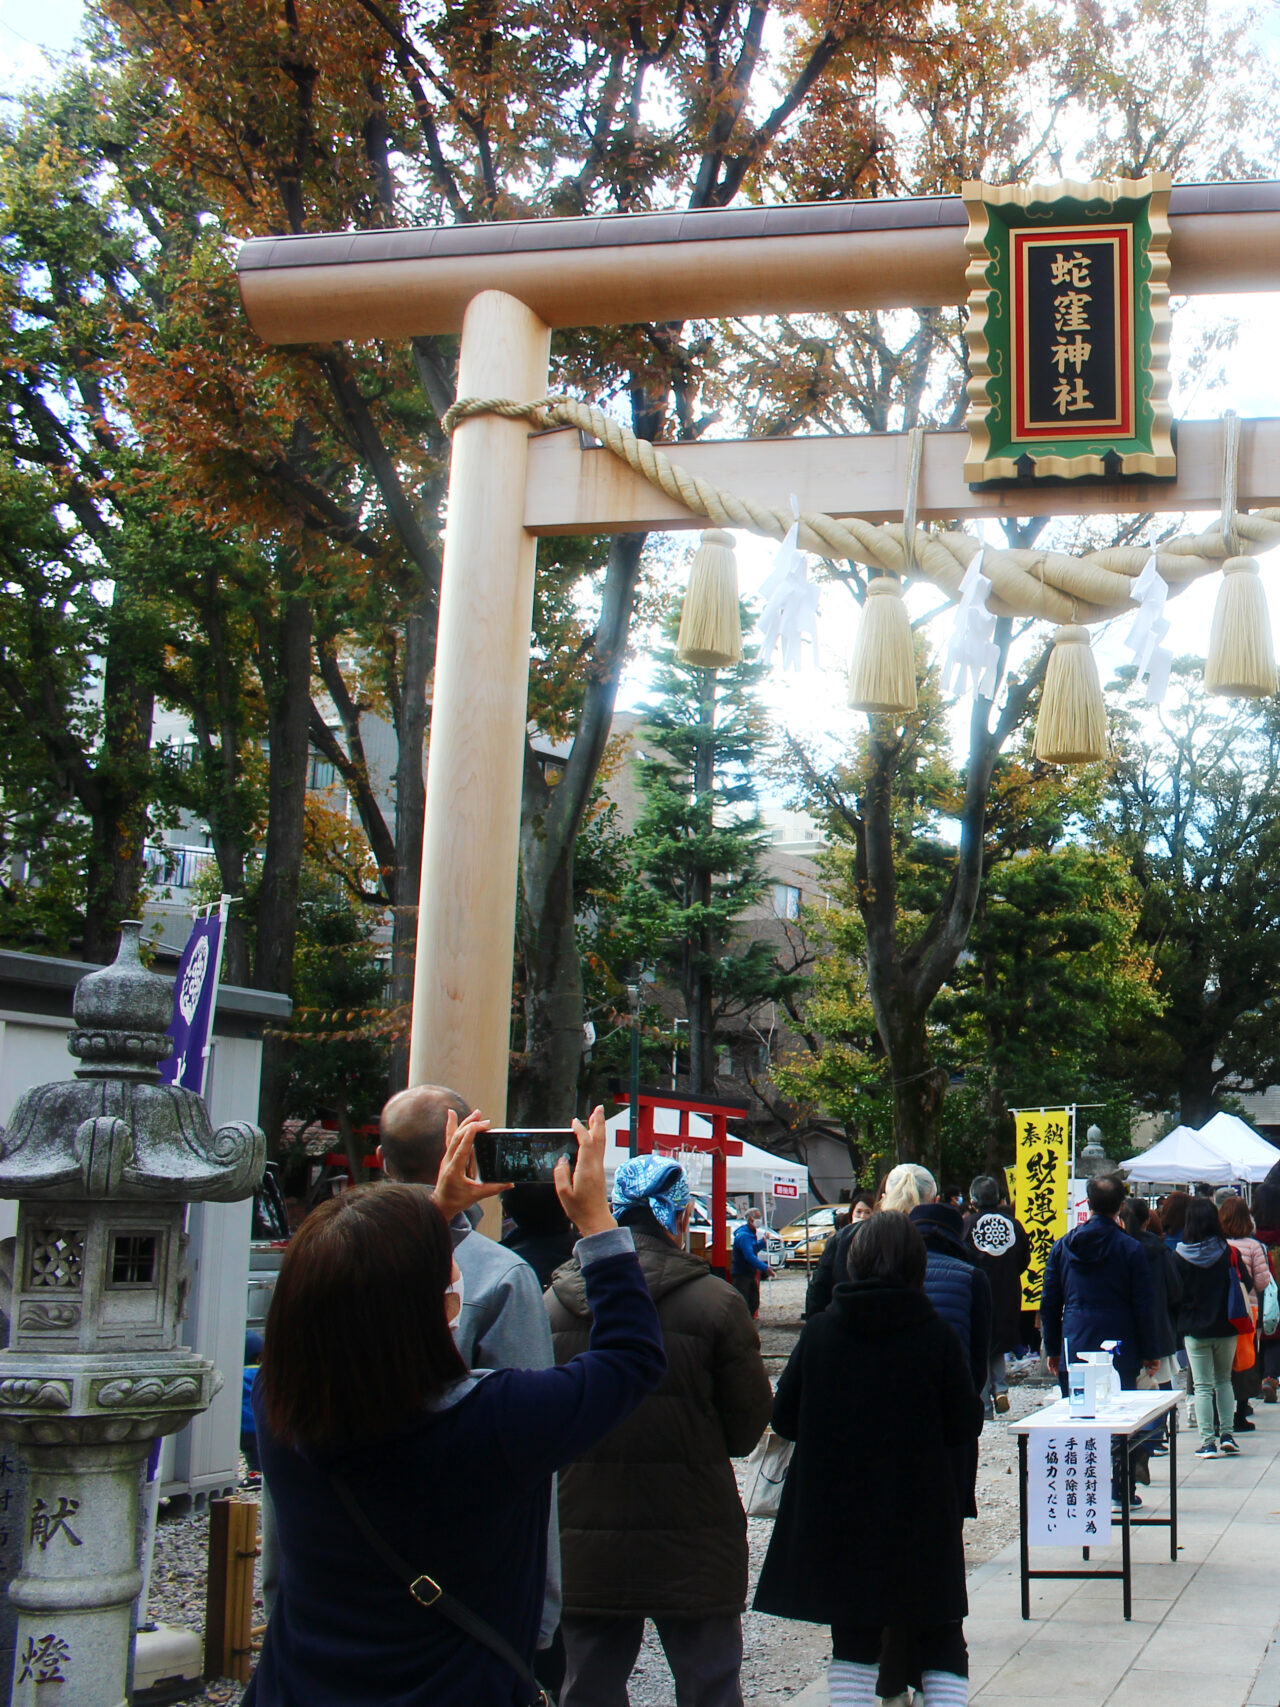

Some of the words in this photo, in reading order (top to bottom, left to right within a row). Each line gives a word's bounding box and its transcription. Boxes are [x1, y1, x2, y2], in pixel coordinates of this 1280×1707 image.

[1050, 251, 1094, 416] 蛇窪神社
[1021, 1122, 1064, 1147] 奉納
[1044, 1438, 1059, 1532] ご協力ください
[1064, 1437, 1079, 1518] 手指の除菌に
[1083, 1437, 1098, 1534] 感染症対策の為
